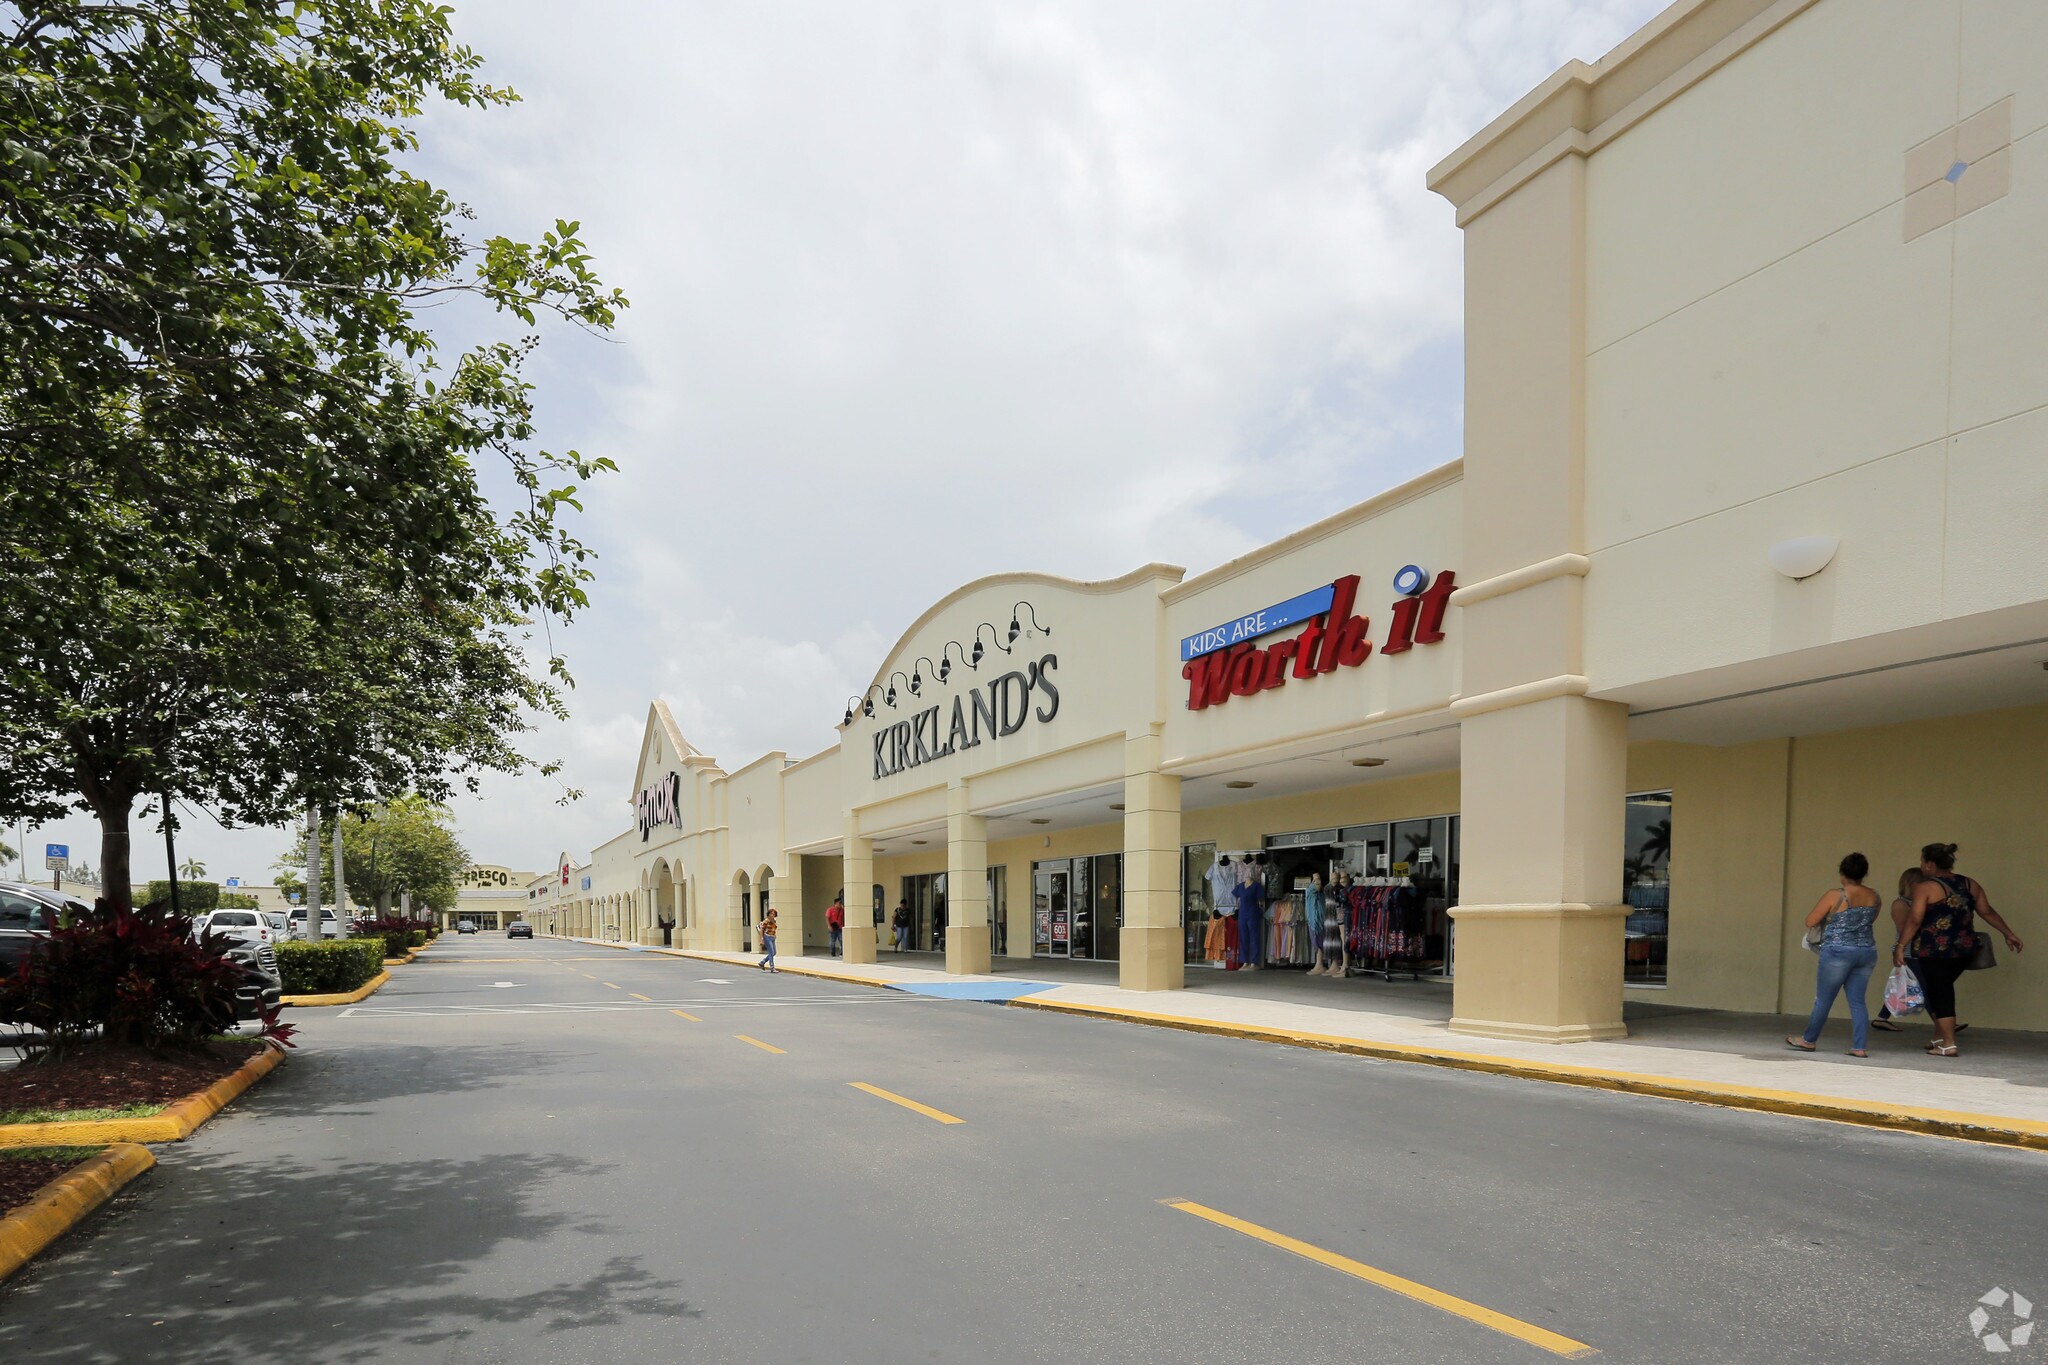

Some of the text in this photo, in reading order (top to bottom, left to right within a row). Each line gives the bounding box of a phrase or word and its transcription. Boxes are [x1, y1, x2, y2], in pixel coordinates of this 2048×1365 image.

[1181, 564, 1459, 711] Worth it
[1189, 628, 1226, 656] KIDS
[1231, 612, 1267, 641] ARE
[872, 653, 1060, 780] KIRKLAND'S
[1293, 834, 1310, 845] 469
